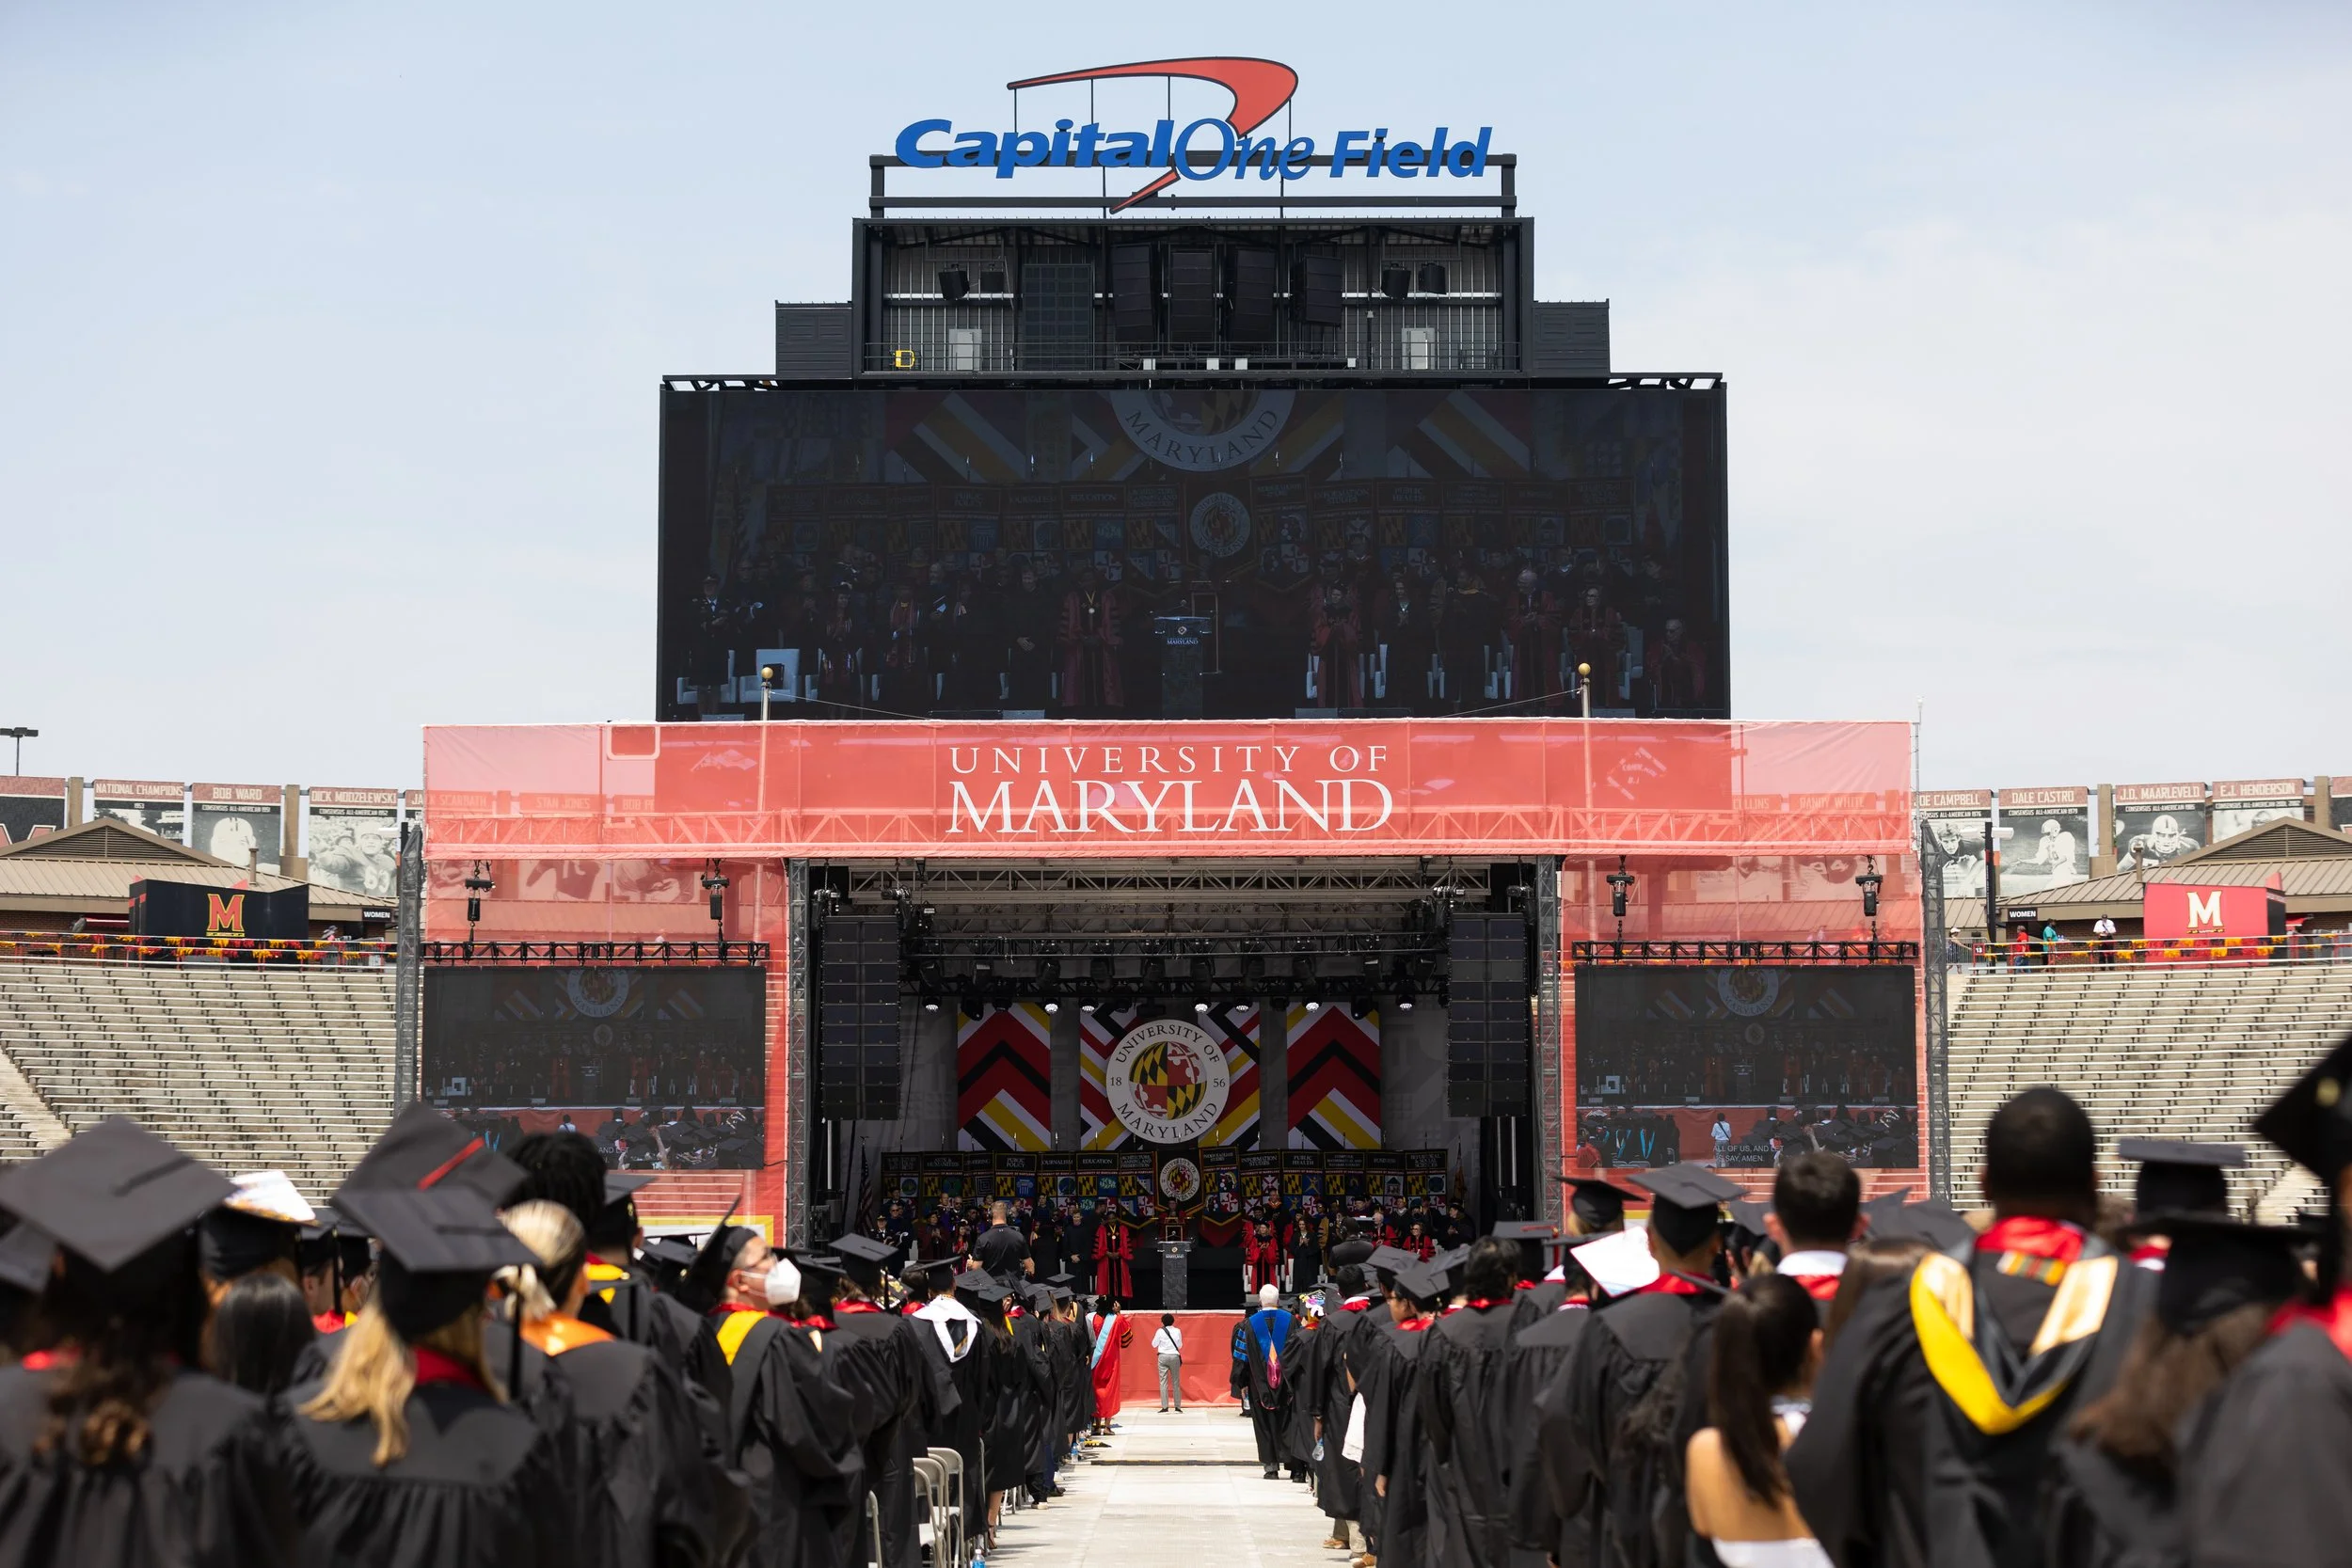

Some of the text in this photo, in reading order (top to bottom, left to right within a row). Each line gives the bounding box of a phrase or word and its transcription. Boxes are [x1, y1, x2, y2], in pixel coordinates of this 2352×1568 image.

[895, 118, 1493, 181] Capital One Field
[1125, 409, 1278, 464] MARYLAND
[949, 745, 1388, 774] UNIVERSITY OF
[96, 783, 183, 797] NATIONAL CHAMPIONS
[213, 787, 262, 800] BOB WARD
[2120, 786, 2200, 800] J.D. MAARLEVELD
[2240, 783, 2296, 796] HENDERSON
[311, 790, 396, 804] DICK MODZELEWSKI
[1934, 794, 1980, 806] CAMPBELL
[2012, 791, 2074, 804] DALE CASTRO
[946, 779, 1393, 834] MARYLAND
[206, 893, 246, 932] M
[2009, 910, 2036, 918] WOMEN
[2186, 890, 2223, 928] M
[1116, 1024, 1220, 1063] UNIVERSITY OF
[1110, 1077, 1226, 1087] 18 56
[1117, 1102, 1217, 1139] MARYLAND
[1740, 1145, 1752, 1153] US,
